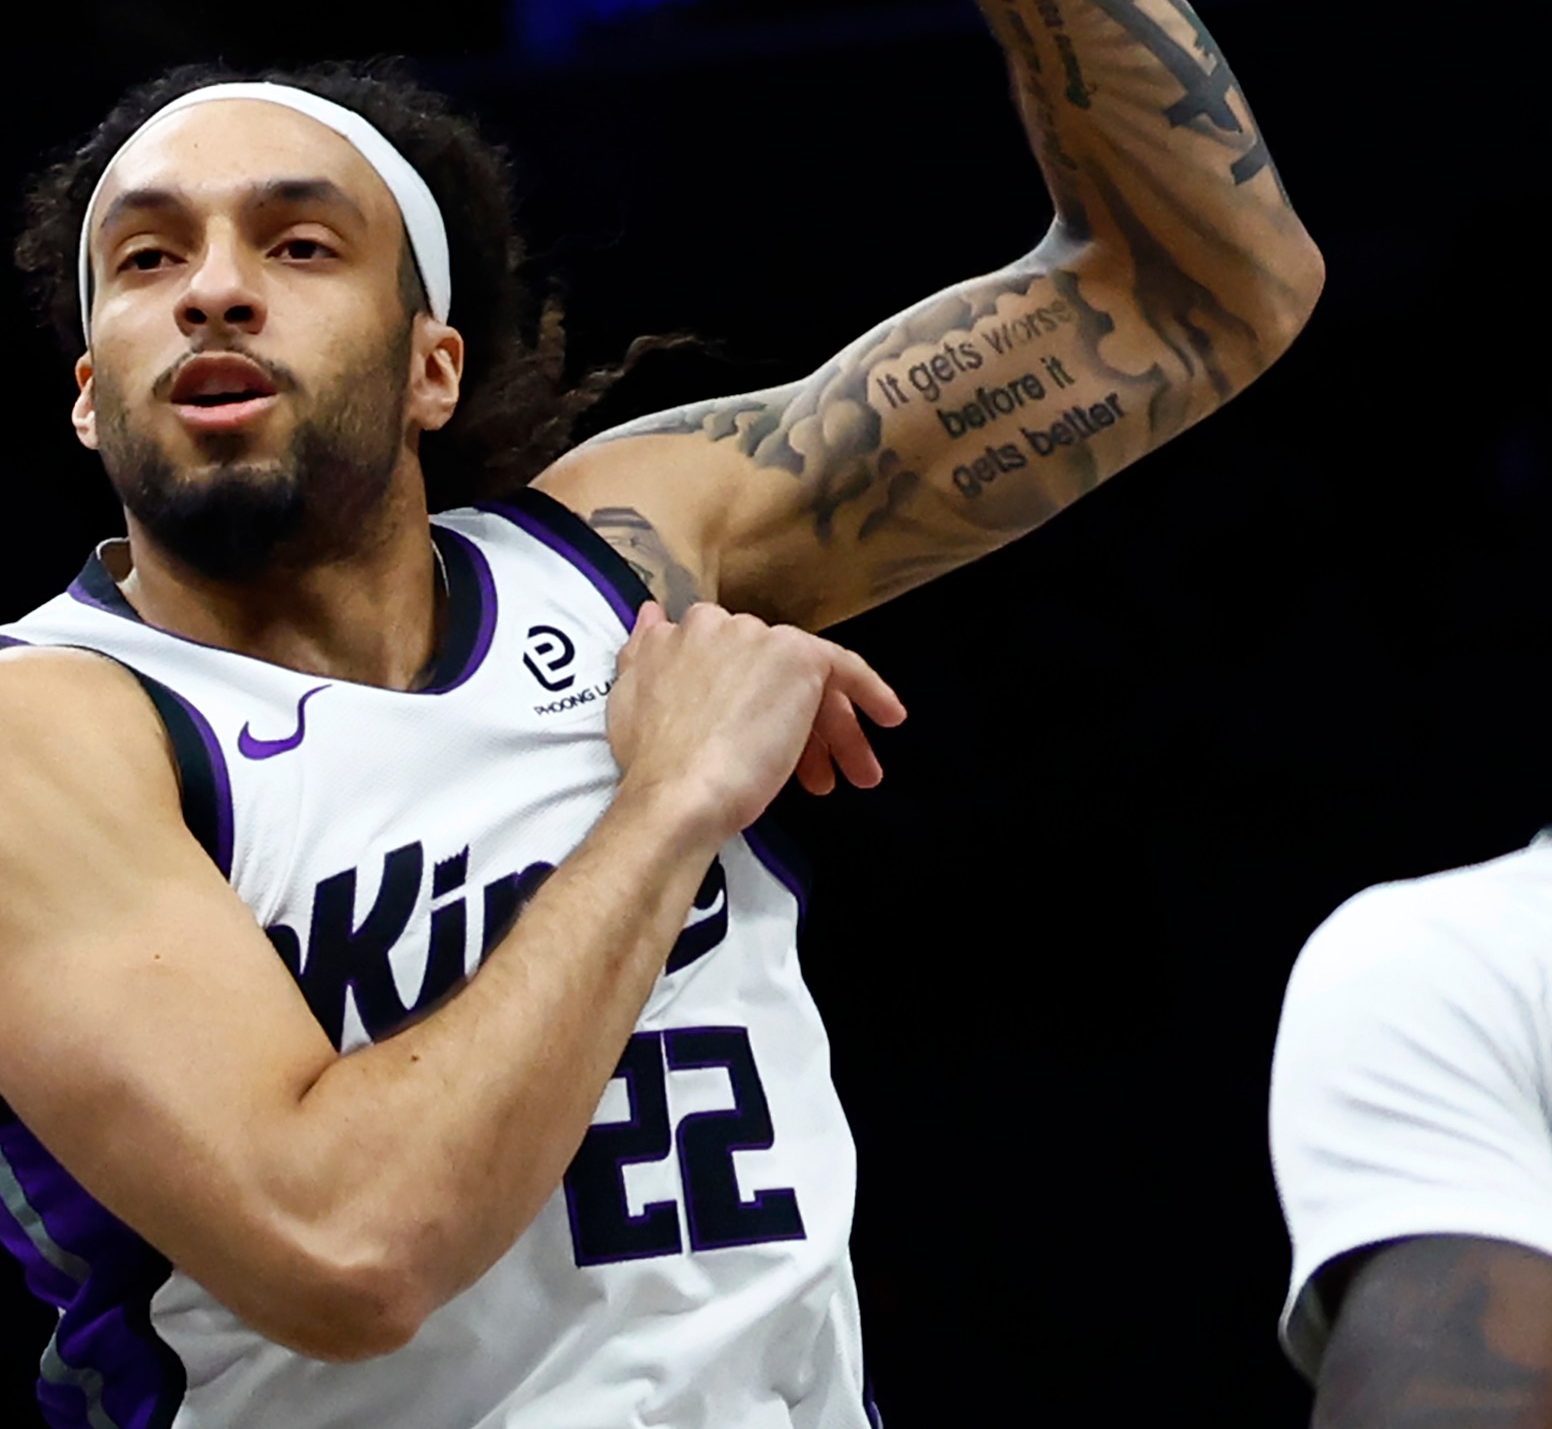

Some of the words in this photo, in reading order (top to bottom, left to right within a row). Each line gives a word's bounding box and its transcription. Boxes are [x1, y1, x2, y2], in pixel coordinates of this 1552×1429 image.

[876, 374, 909, 408] It
[908, 340, 984, 403] gets
[936, 373, 1045, 439] before
[1040, 355, 1075, 389] it
[952, 443, 1027, 498] gets
[1020, 392, 1124, 456] better
[563, 1026, 806, 1267] 22
